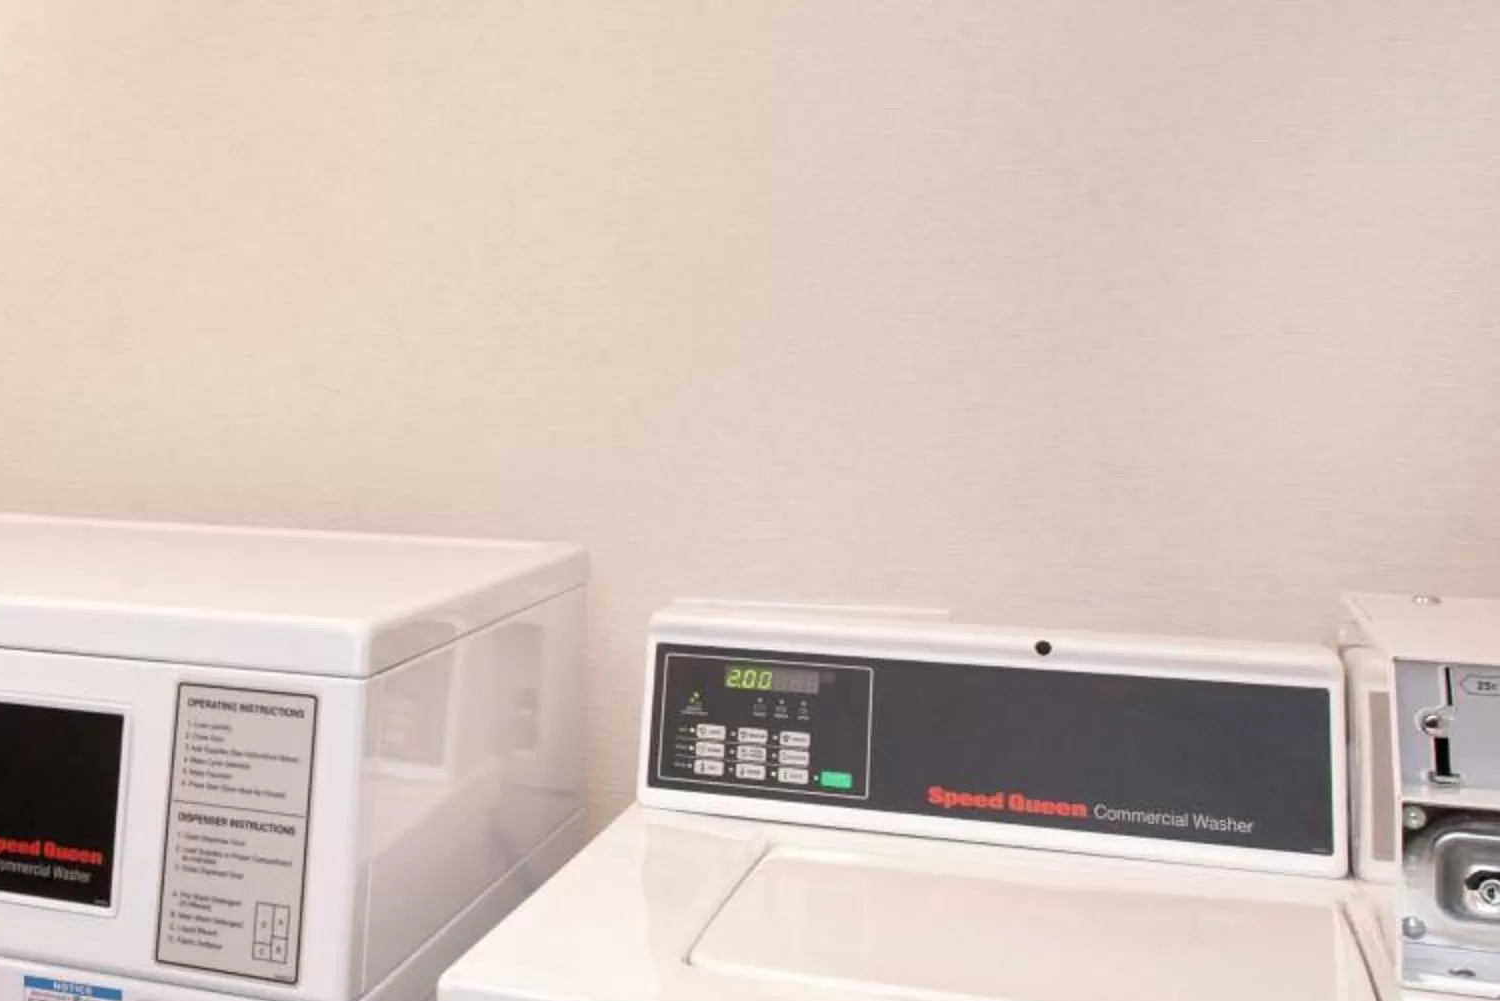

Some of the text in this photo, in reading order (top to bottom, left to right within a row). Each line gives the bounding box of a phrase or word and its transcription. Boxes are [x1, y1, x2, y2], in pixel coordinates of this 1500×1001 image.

[927, 785, 1254, 834] Speed Queen Commercial Washer
[43, 840, 103, 866] Queen
[52, 864, 93, 884] Washer
